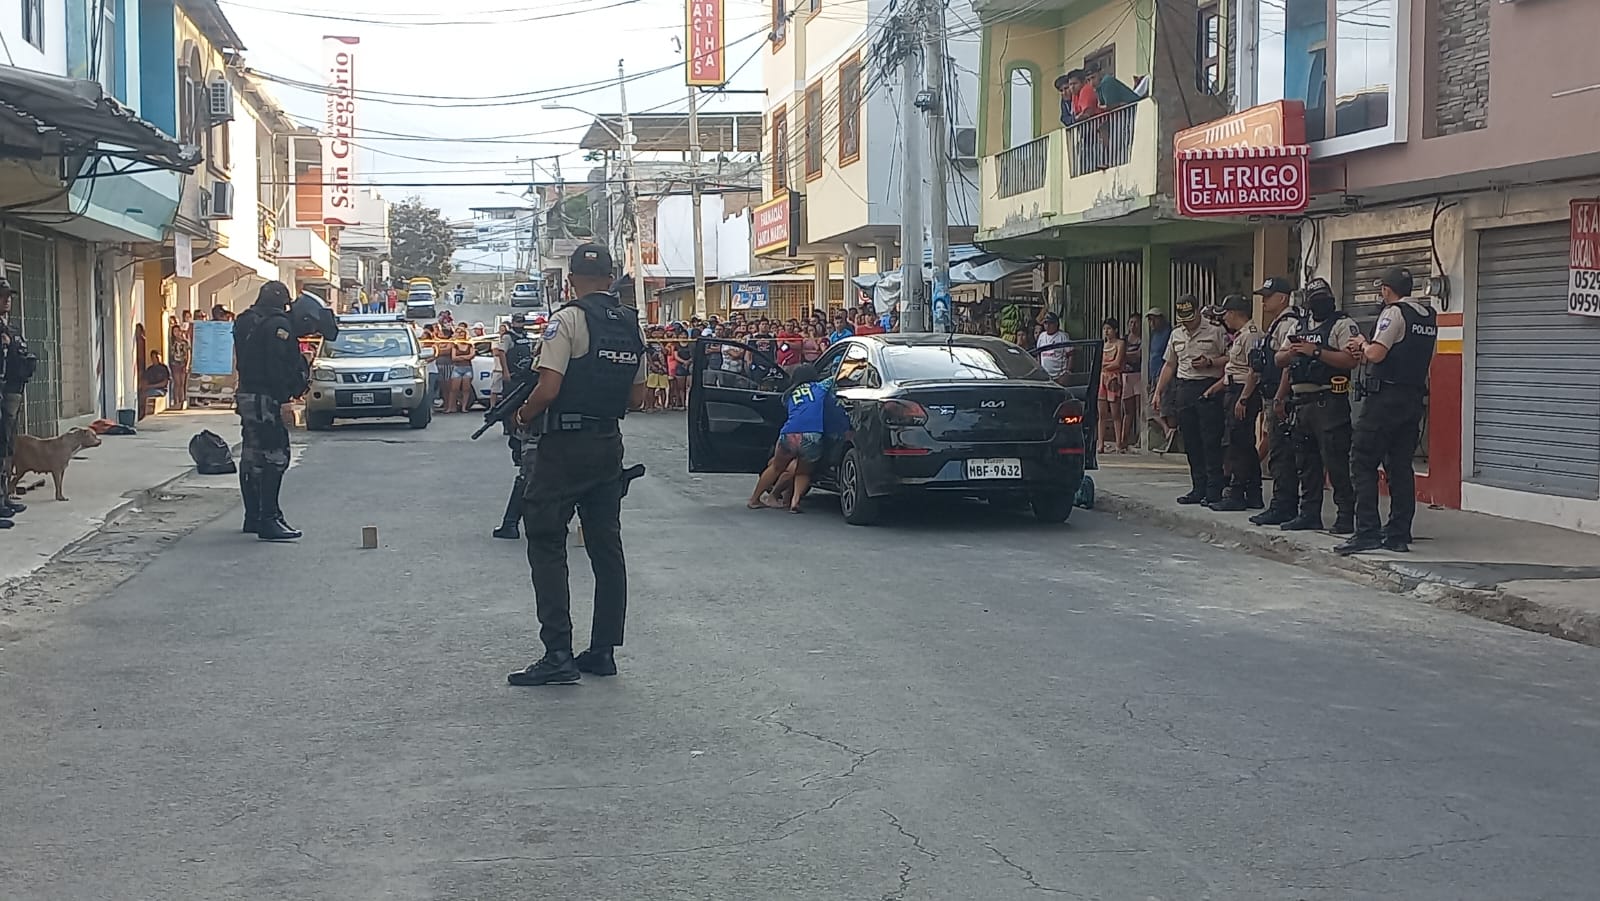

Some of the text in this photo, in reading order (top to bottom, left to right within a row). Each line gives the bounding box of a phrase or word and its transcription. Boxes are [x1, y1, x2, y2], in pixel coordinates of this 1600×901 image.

[692, 0, 703, 75] ACIAS
[331, 52, 355, 208] San Gregorio
[1190, 164, 1298, 190] EL FRIGO
[1191, 187, 1299, 205] DE MI BARRIO
[1577, 204, 1600, 233] SE A
[1569, 292, 1600, 313] 0959
[598, 350, 638, 361] POLICIA
[791, 386, 814, 405] 29
